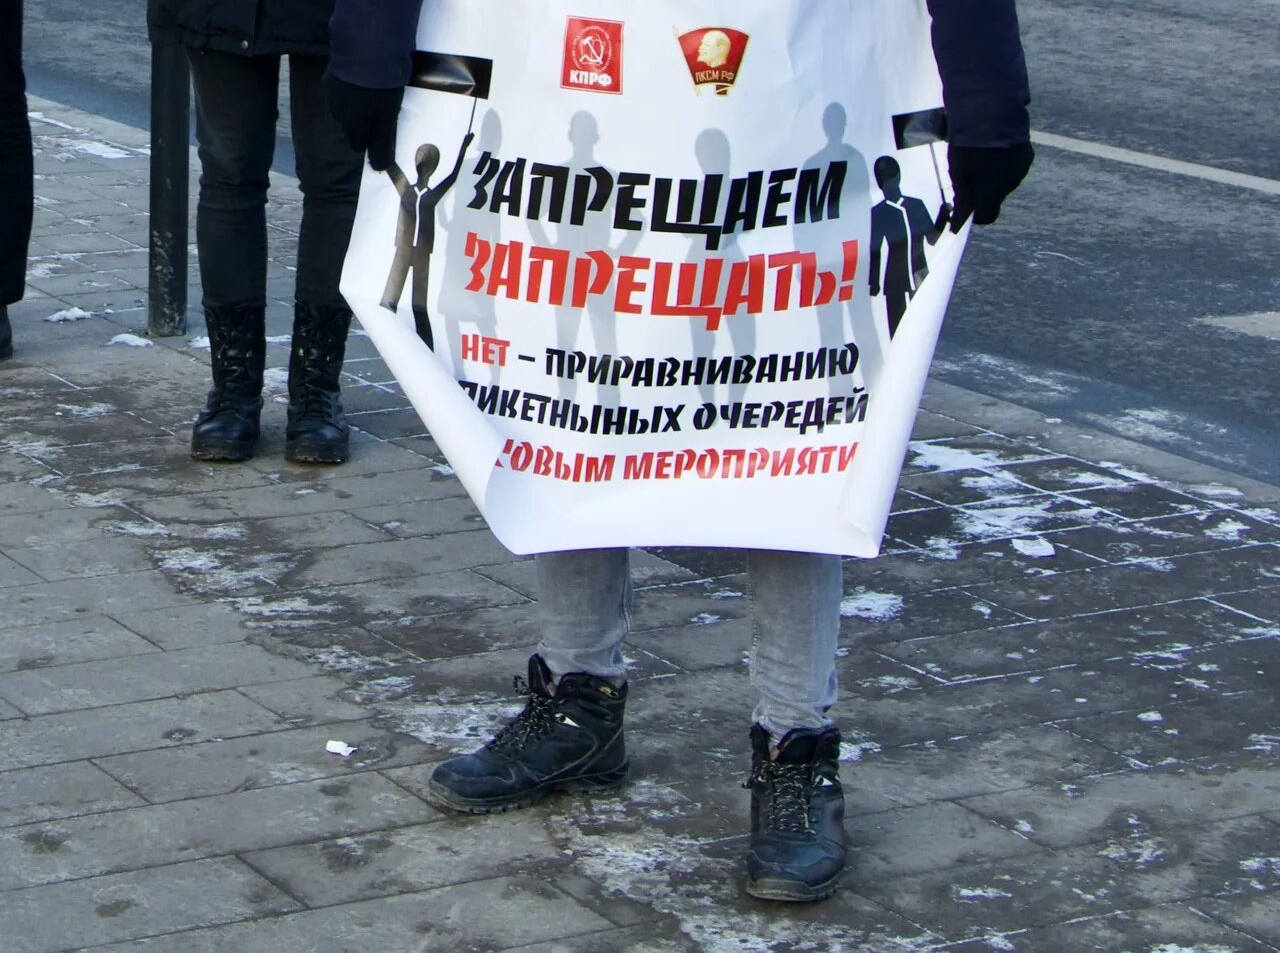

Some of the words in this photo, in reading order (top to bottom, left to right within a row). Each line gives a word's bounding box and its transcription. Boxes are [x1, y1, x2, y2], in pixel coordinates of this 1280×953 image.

[569, 69, 612, 86] КПРФ
[721, 70, 735, 81] РФ
[467, 151, 847, 250] ЗАПРЕЩАЕМ
[464, 232, 858, 331] ЗАПРЕЩАТЬ!
[461, 333, 511, 367] НЕТ
[545, 342, 860, 387] ПРИРАВНИВАНИЮ
[692, 386, 869, 435] ОЧЕРЕДЕЙ
